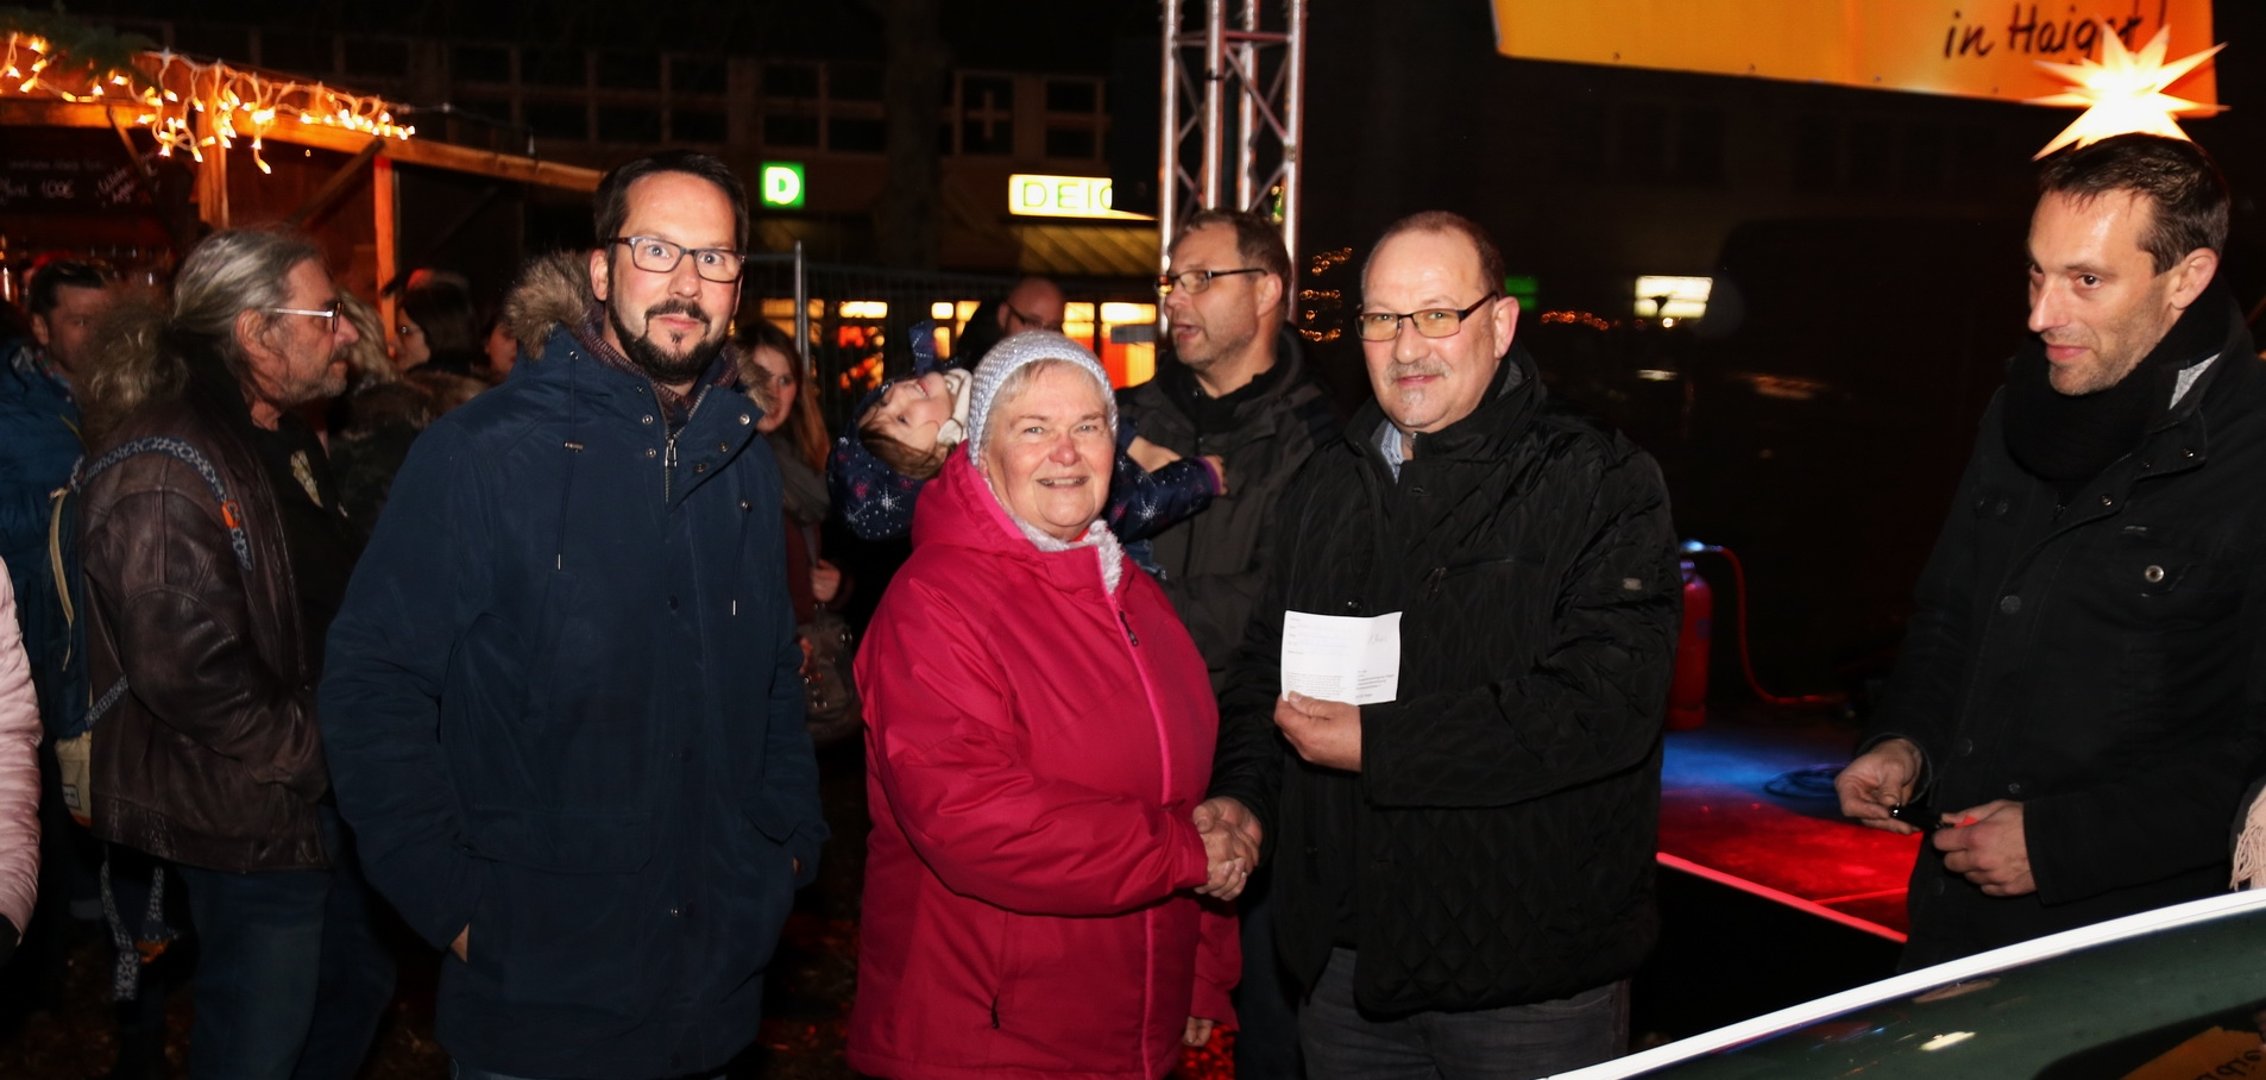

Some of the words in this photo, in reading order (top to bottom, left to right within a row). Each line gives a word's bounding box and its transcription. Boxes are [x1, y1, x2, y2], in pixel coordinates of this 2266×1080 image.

[1944, 10, 1996, 58] in
[2008, 0, 2168, 61] Haigr!
[764, 165, 801, 205] D
